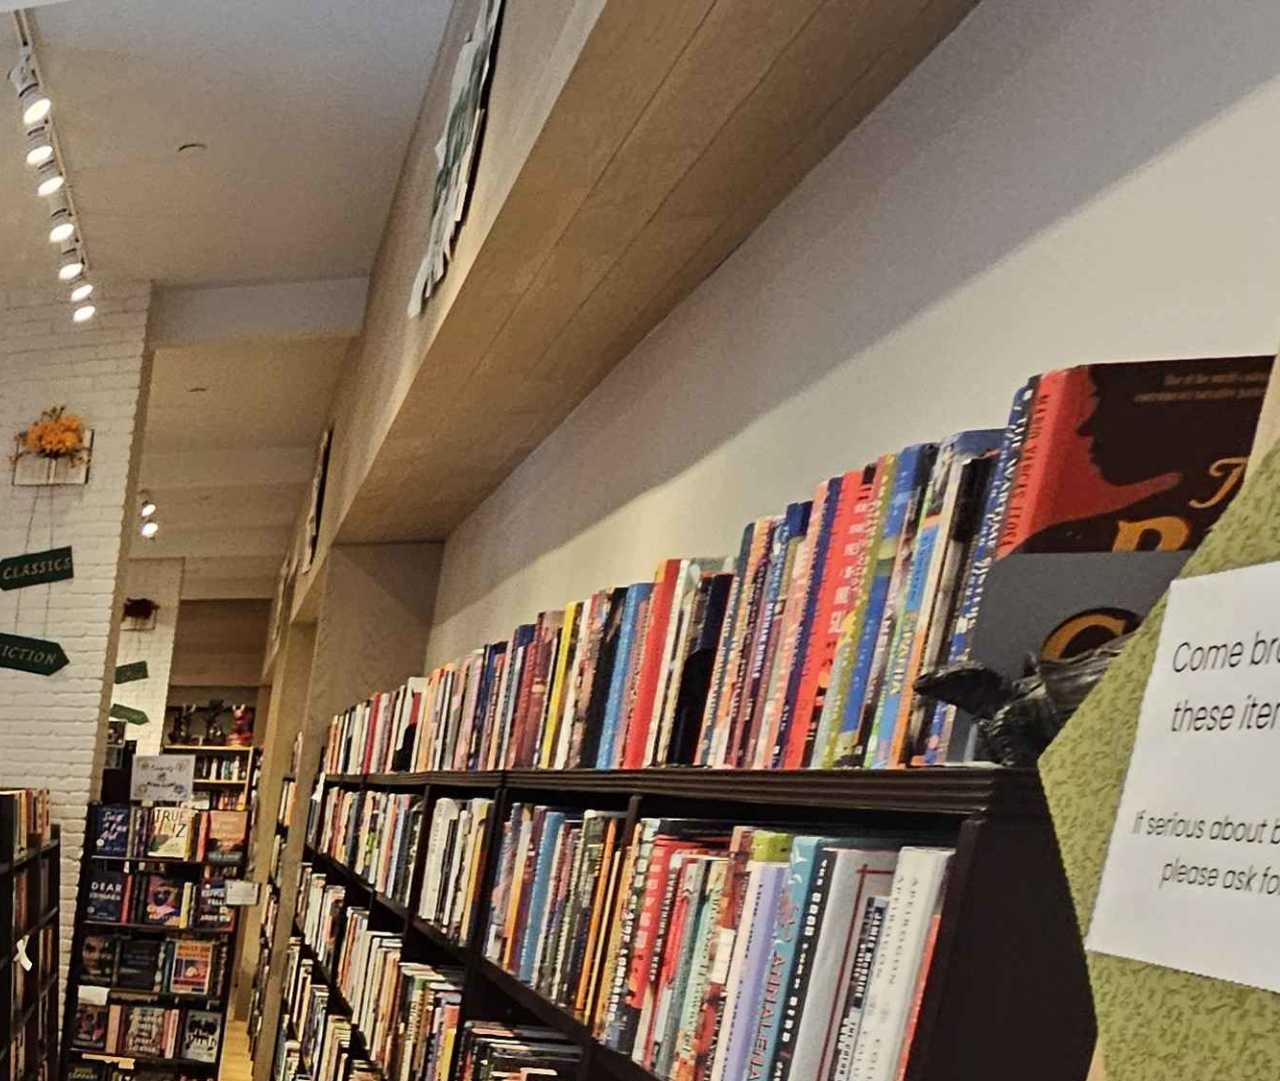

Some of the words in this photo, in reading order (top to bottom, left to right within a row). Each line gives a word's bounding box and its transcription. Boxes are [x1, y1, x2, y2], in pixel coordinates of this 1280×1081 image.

[2, 557, 71, 580] CLASSICS
[1172, 640, 1244, 673] Come
[1249, 631, 1280, 669] br
[1170, 700, 1235, 733] these
[1132, 810, 1146, 835] If
[1146, 812, 1206, 840] serious
[1209, 815, 1268, 844] about
[91, 881, 122, 893] DEAR
[1159, 857, 1219, 889] please
[1222, 864, 1257, 892] ask
